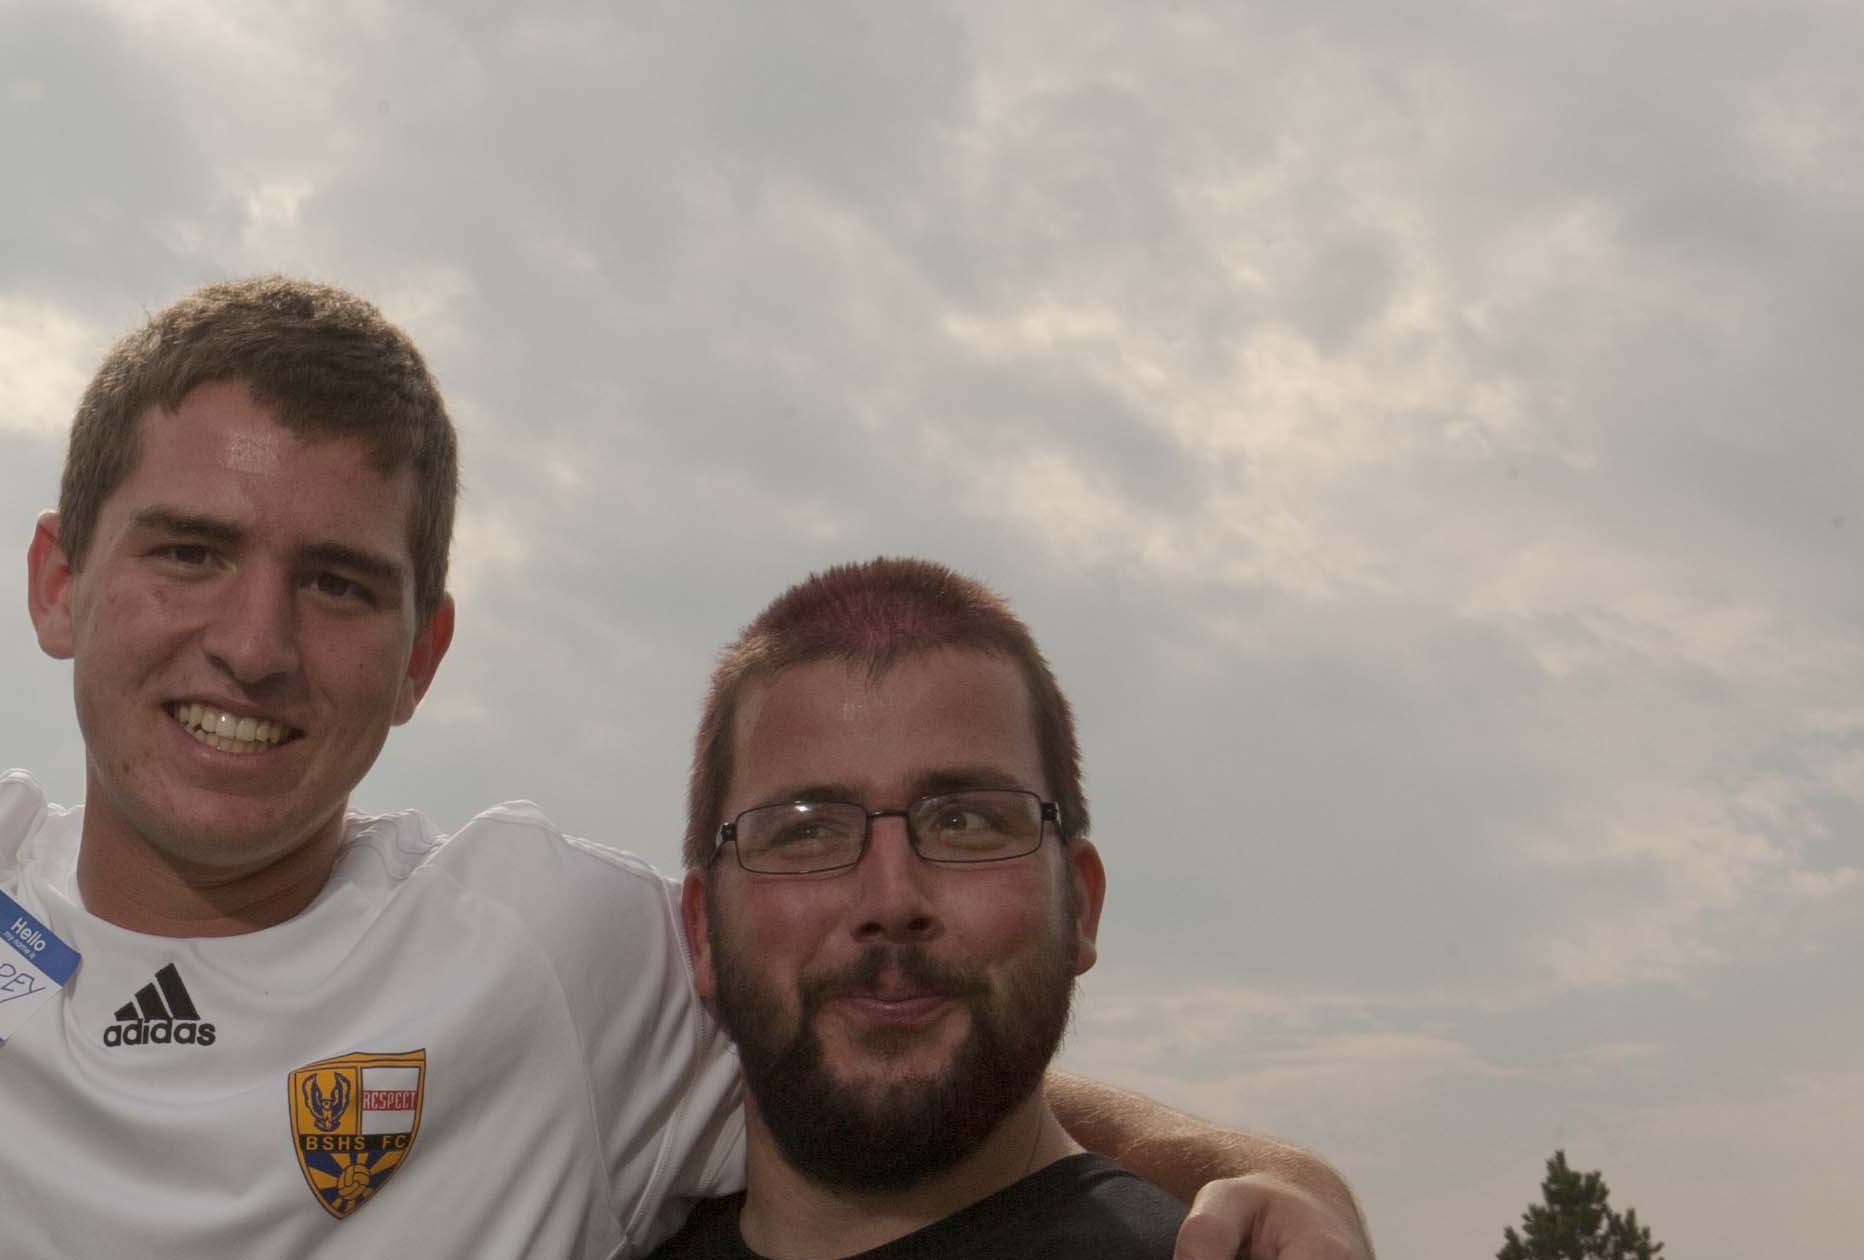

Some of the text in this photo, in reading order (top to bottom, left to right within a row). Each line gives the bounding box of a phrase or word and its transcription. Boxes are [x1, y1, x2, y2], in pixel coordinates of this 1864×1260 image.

[10, 917, 46, 952] Hello
[103, 1017, 216, 1048] adidas
[363, 1090, 416, 1110] RESPECT
[305, 1135, 407, 1151] BSHS FC
